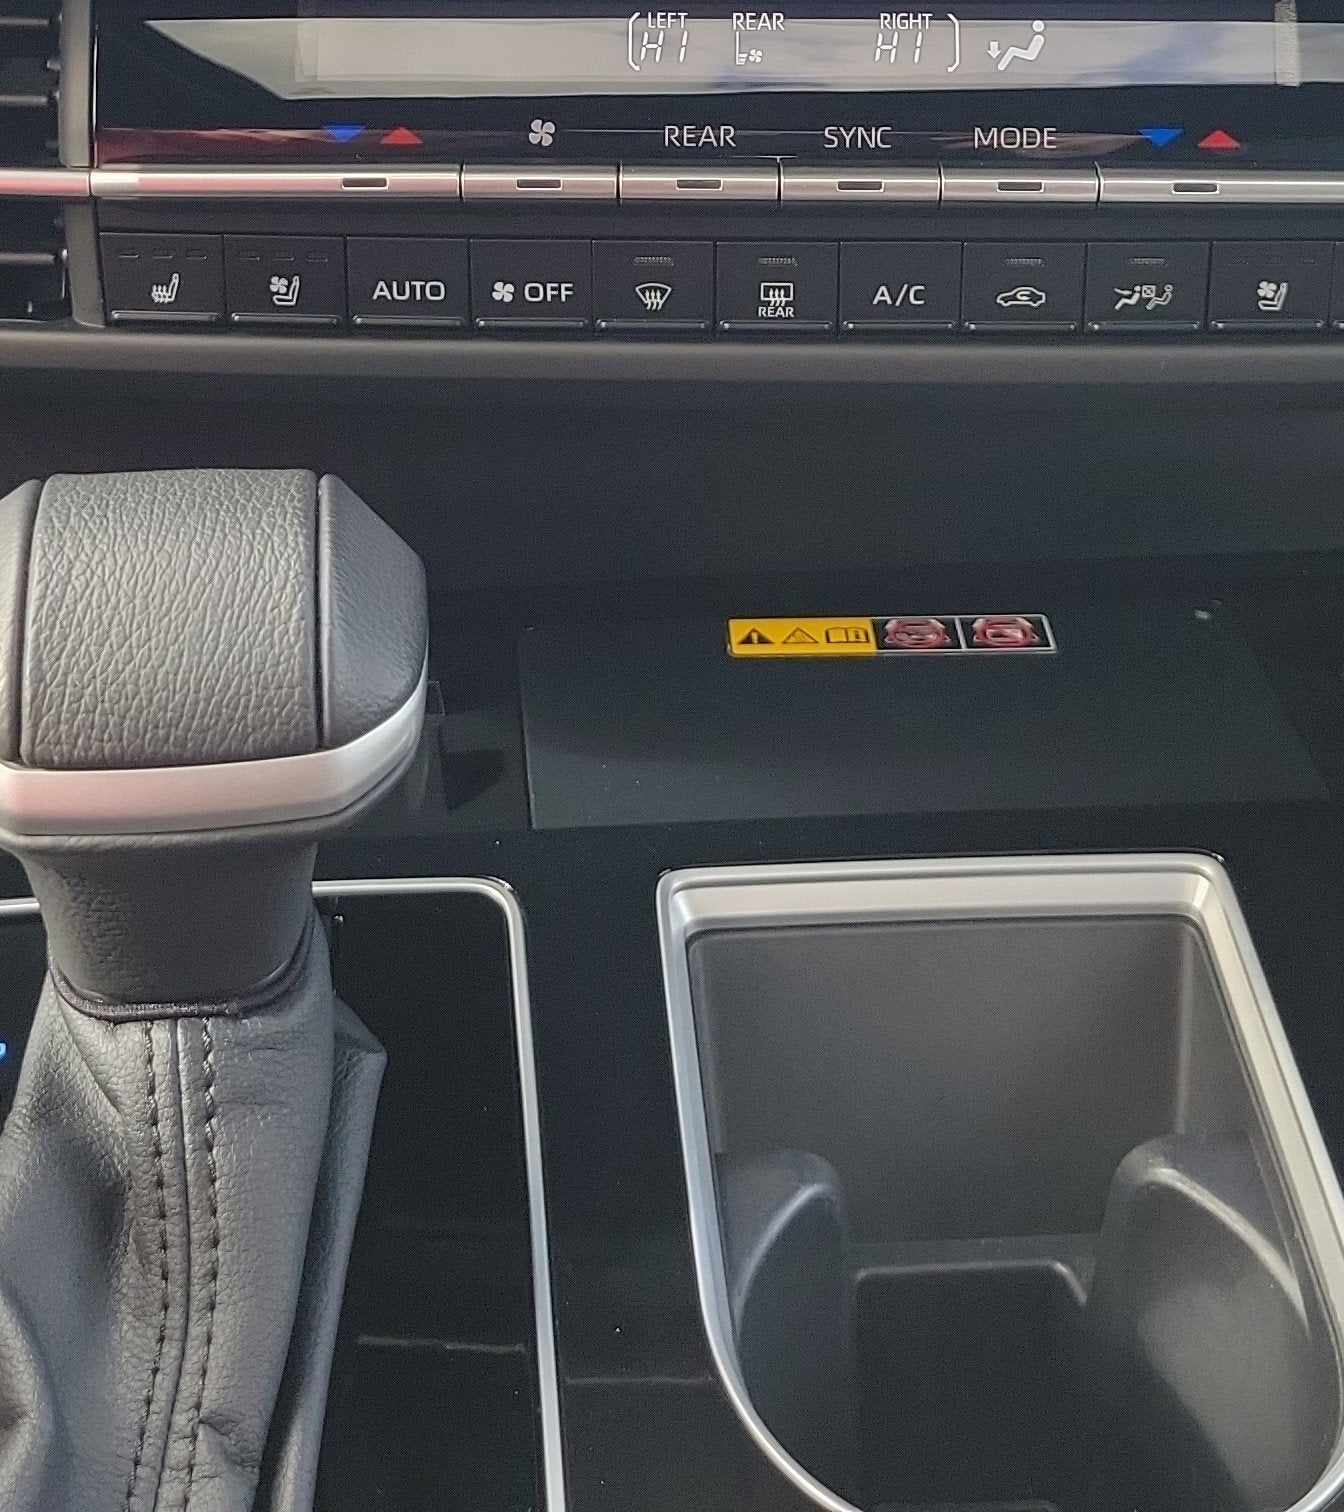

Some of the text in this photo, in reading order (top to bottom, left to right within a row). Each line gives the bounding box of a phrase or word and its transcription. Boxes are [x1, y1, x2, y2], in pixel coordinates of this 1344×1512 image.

[647, 12, 688, 29] LEFT
[732, 12, 785, 31] REAR
[880, 13, 933, 30] RIGHT
[663, 125, 737, 147] REAR
[823, 126, 893, 149] SYNC
[973, 126, 1058, 149] MODE
[372, 281, 446, 301] AUTO
[524, 283, 574, 303] OFF
[872, 284, 926, 307] A/C
[758, 307, 795, 319] REAR
